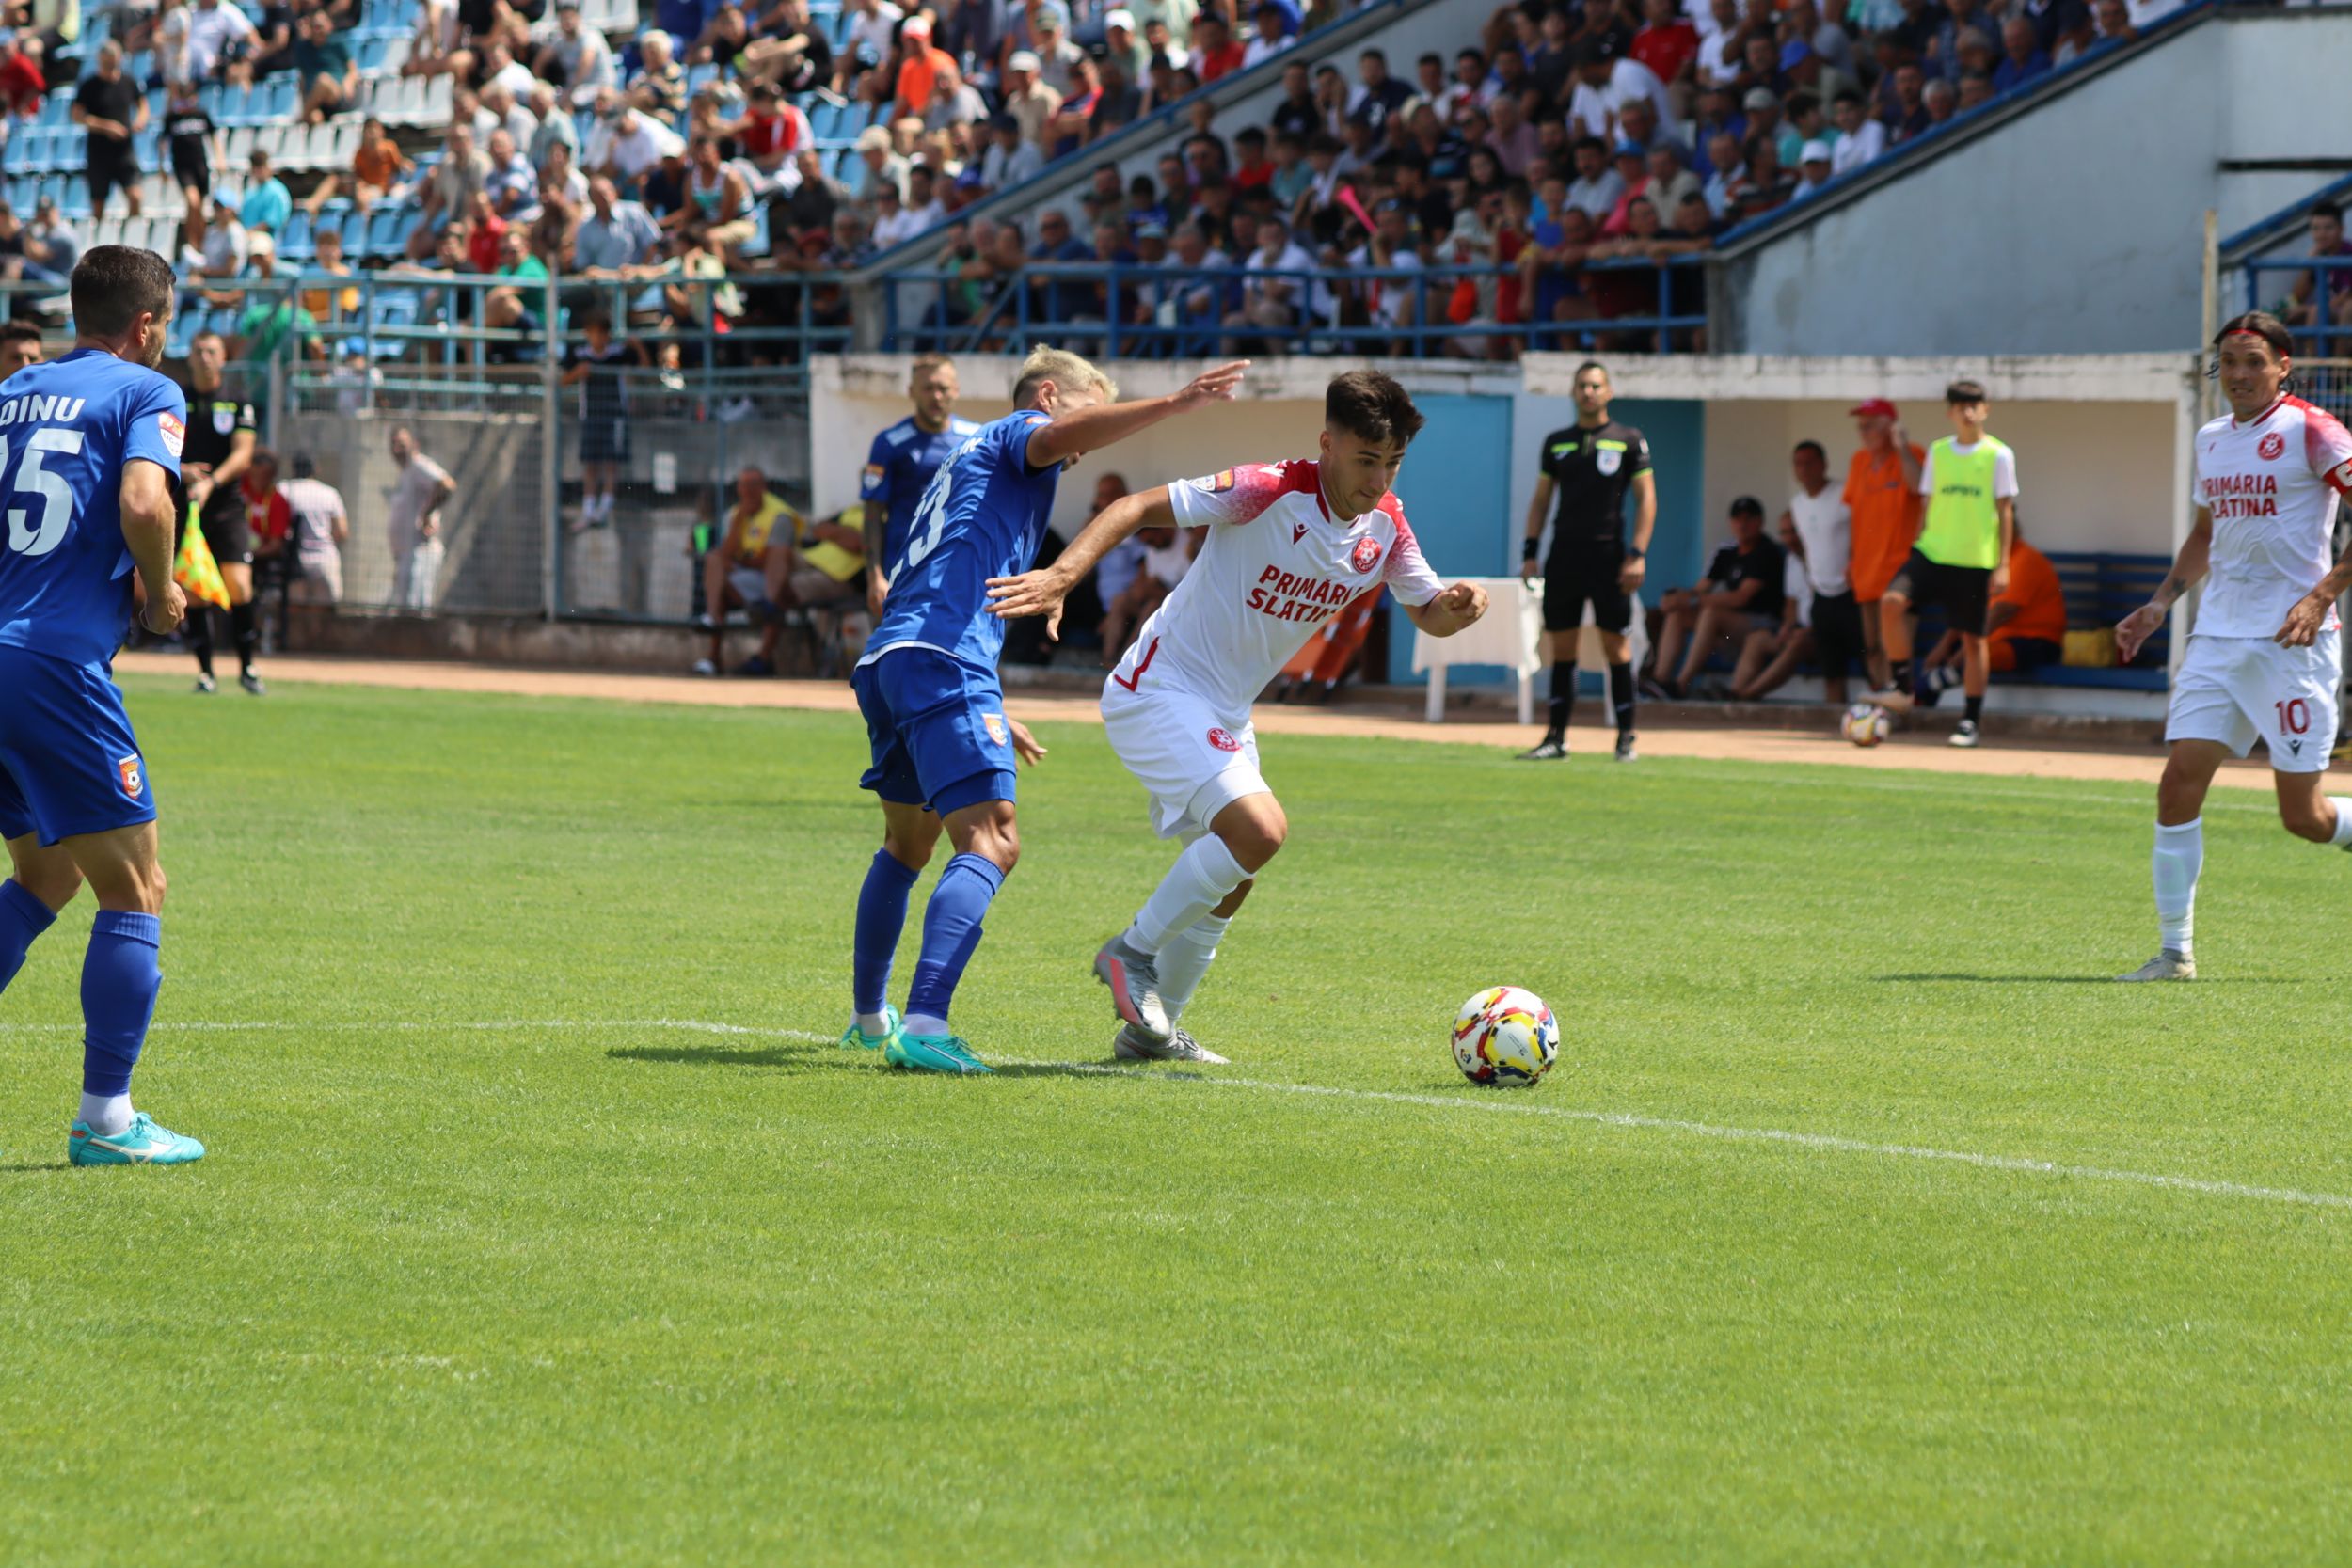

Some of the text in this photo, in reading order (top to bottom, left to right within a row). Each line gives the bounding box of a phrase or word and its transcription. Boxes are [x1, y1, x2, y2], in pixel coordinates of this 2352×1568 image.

[0, 394, 86, 425] DINU
[2209, 498, 2277, 518] LATINA
[1246, 587, 1337, 623] SLATIN
[2275, 698, 2311, 736] 10
